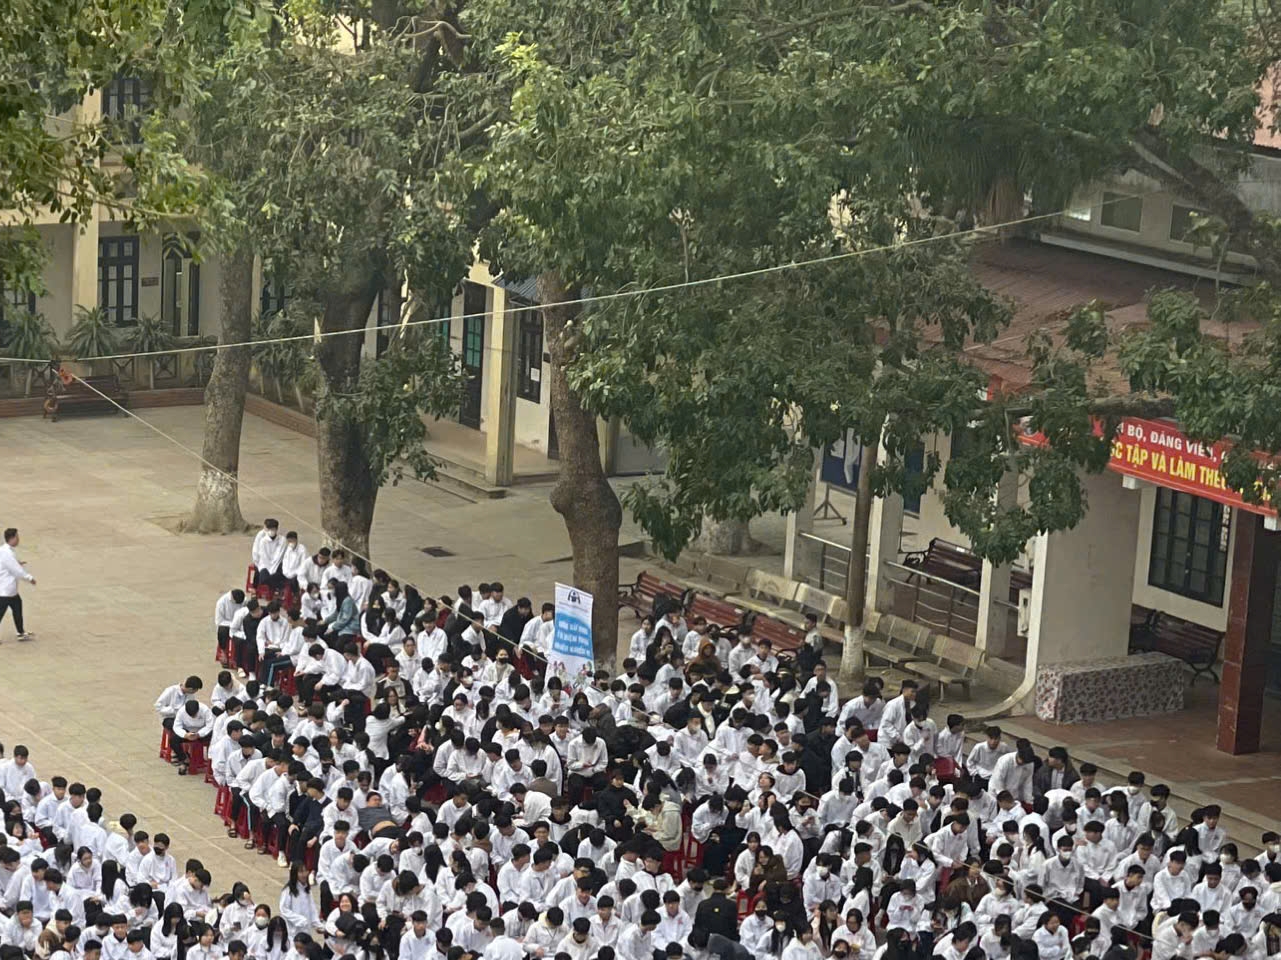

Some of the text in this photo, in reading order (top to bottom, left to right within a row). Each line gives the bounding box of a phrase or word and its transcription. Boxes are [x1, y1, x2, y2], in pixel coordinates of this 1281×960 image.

[1126, 444, 1149, 470] TẬP
[1151, 451, 1167, 473] VÀ
[1169, 455, 1196, 481] LÀM
